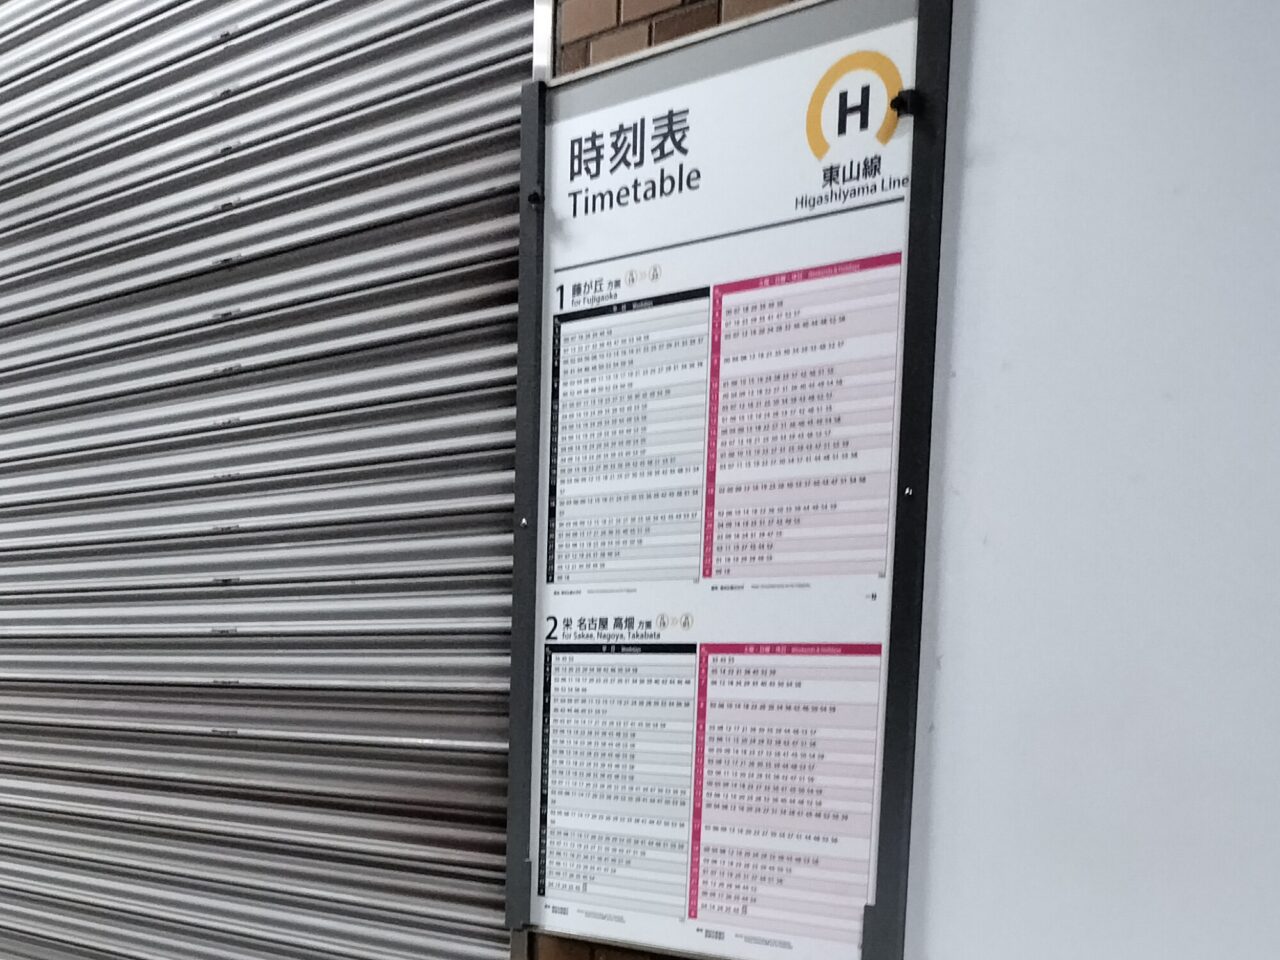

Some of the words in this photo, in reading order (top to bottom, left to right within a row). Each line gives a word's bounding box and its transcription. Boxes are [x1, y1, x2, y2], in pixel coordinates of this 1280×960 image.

[837, 84, 870, 137] H
[569, 108, 690, 182] 時刻表
[822, 153, 882, 189] 東山線
[568, 162, 701, 219] Timetable
[795, 182, 877, 211] Higashiyama
[881, 175, 910, 192] Line
[556, 284, 564, 310] 1
[545, 616, 558, 640] 2
[577, 617, 609, 631] 名古屋
